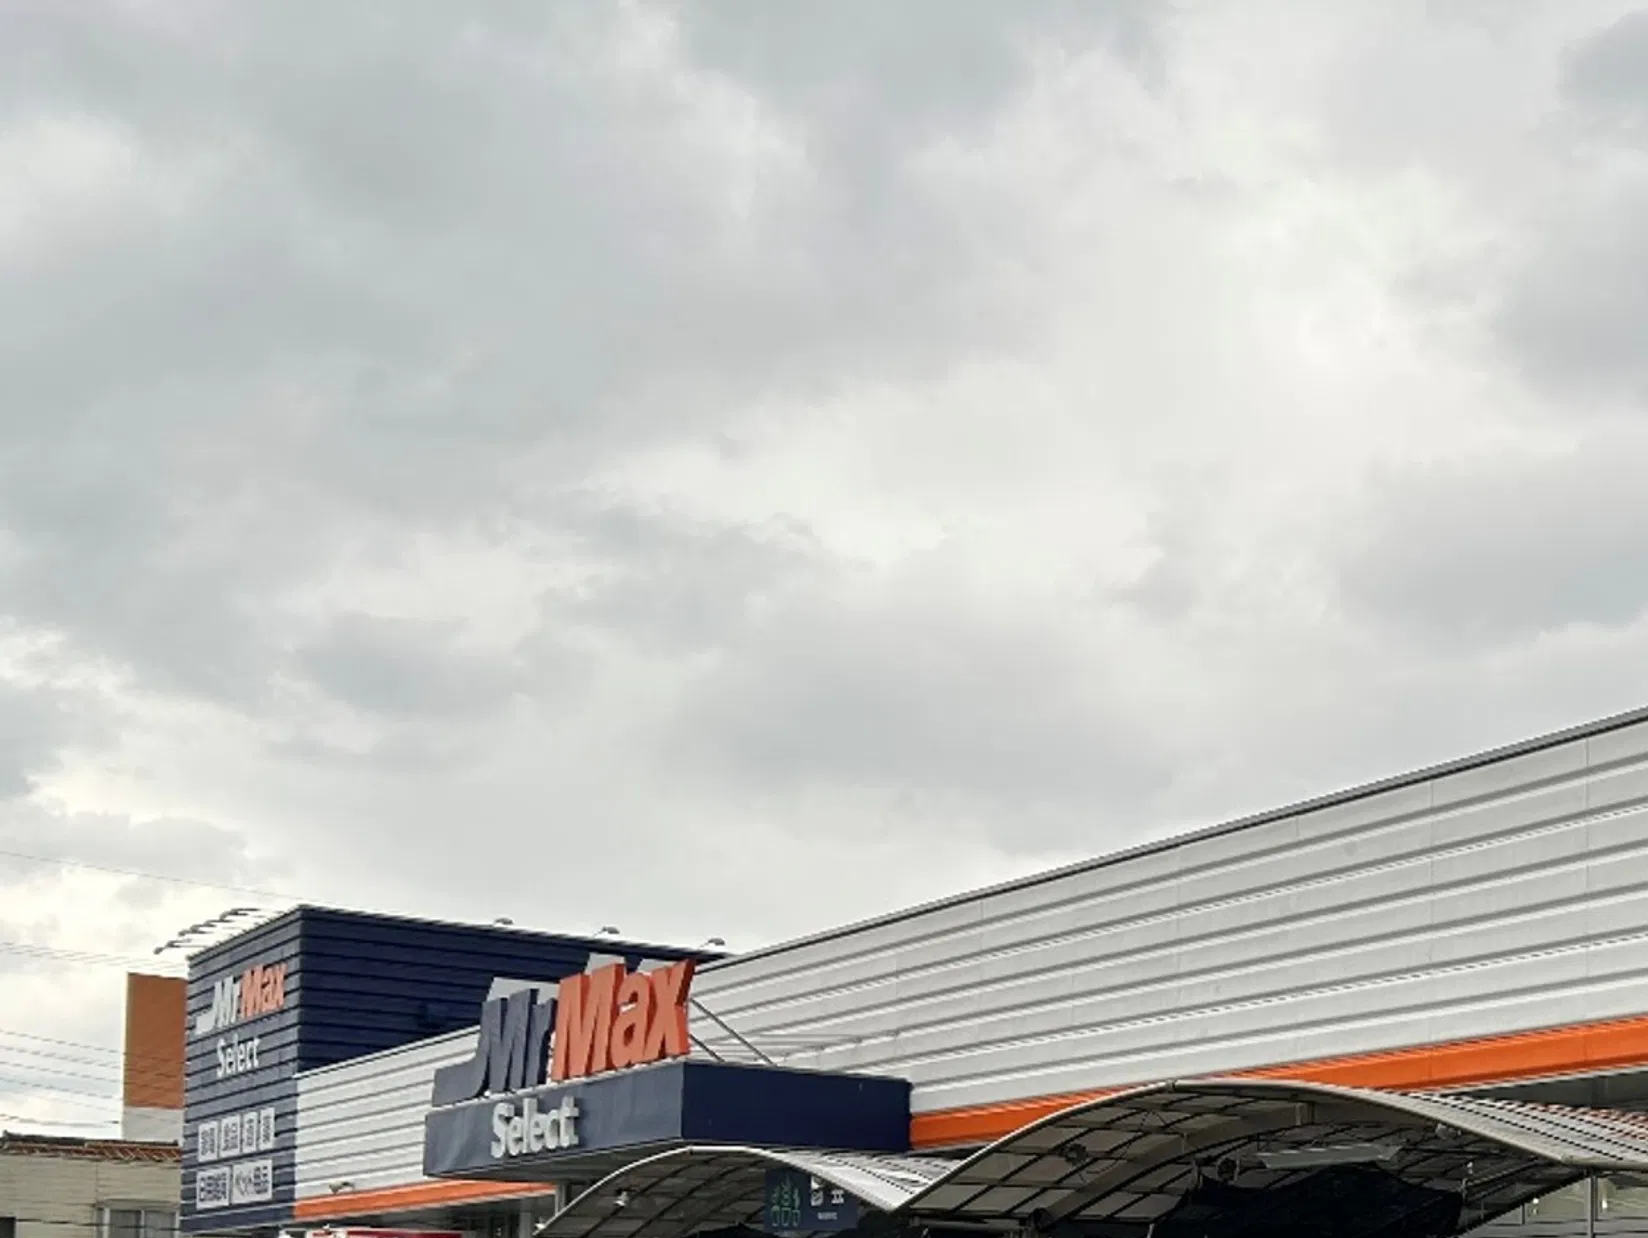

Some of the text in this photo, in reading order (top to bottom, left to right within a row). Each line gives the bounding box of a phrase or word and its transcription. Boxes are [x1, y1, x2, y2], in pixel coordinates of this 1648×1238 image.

[195, 963, 287, 1035] MrMax
[216, 1033, 260, 1078] Select
[431, 959, 696, 1108] MrMax
[490, 1096, 579, 1159] Select
